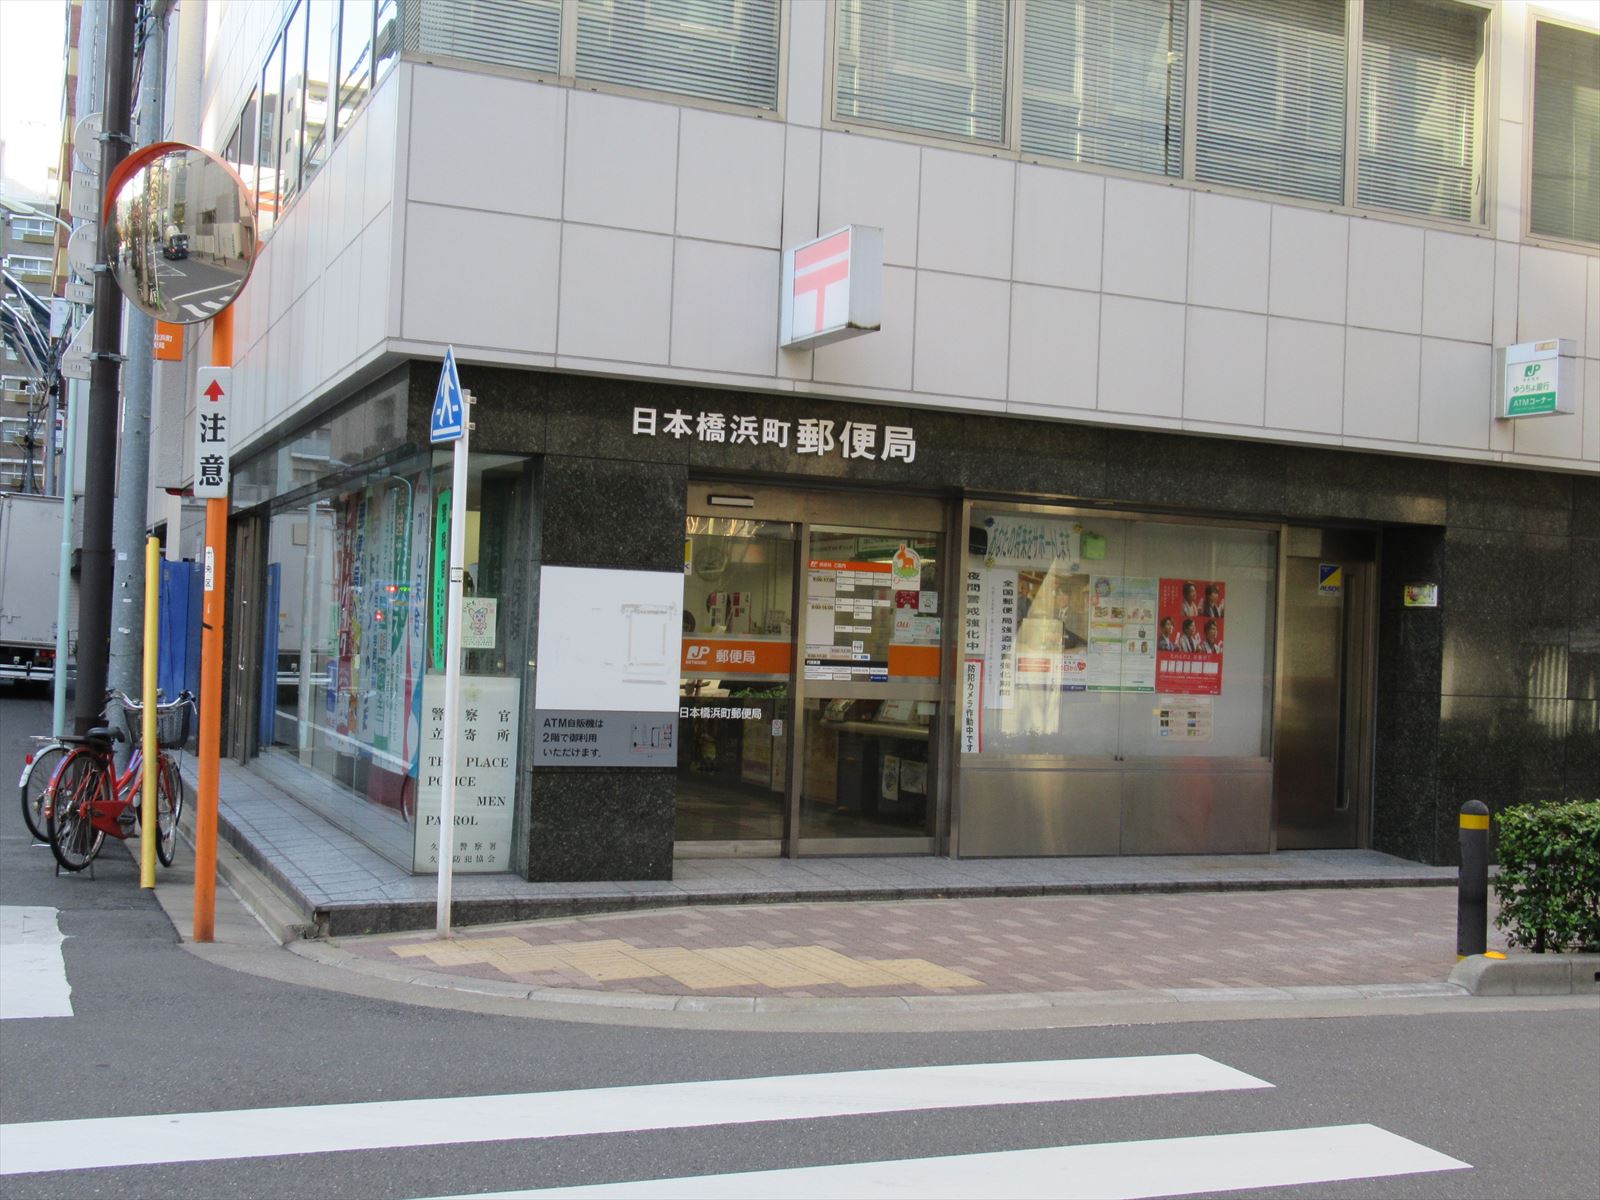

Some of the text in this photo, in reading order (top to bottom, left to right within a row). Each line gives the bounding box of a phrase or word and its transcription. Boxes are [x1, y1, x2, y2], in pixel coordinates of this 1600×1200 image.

[1524, 363, 1541, 377] JP
[1512, 381, 1551, 393] ゆうちょ銀行
[1513, 397, 1553, 407] ATMコーナー
[632, 407, 917, 464] 日本橋浜町郵便局
[200, 412, 226, 487] 注意
[966, 571, 981, 651] 夜間警戒強化中
[687, 645, 710, 660] JP
[716, 649, 756, 664] 郵便局
[431, 707, 511, 723] 警察官
[680, 706, 762, 720] 日本橋浜町郵便局
[965, 664, 976, 753] 防犯カメラ作動中です
[543, 717, 604, 729] ATM自販機は
[430, 727, 510, 742] 立寄所
[542, 732, 598, 743] 2階で御利用
[466, 757, 509, 768] PLACE
[428, 776, 476, 787] POICE
[476, 796, 506, 806] MEN
[425, 815, 478, 826] PAROL
[430, 842, 496, 851] 久警察署
[429, 855, 496, 863] 久防犯協会
